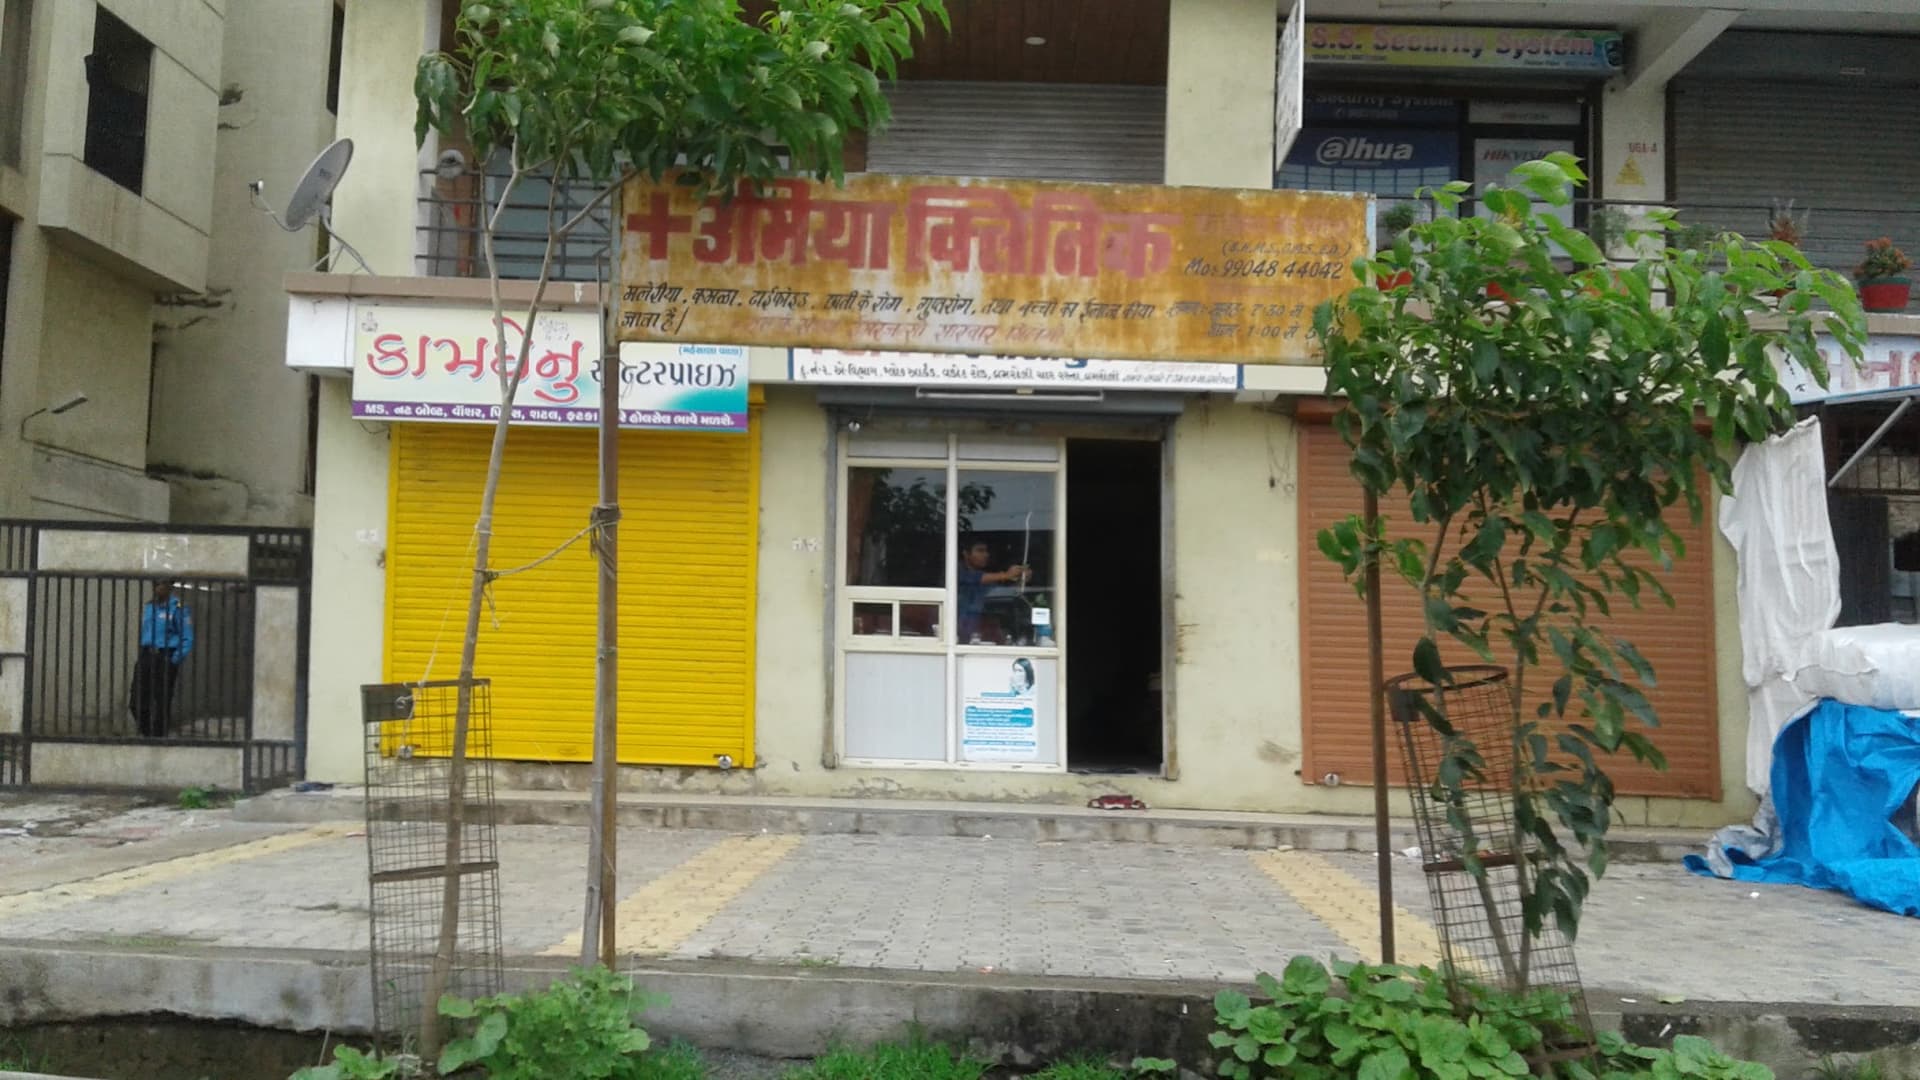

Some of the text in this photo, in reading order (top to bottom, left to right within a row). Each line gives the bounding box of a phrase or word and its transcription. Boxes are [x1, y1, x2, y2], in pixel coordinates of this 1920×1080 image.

[1373, 27, 1486, 58] Security
[1495, 31, 1594, 59] System
[1219, 259, 1280, 279] 99048
[1281, 260, 1344, 280] 44042
[367, 316, 585, 404] કામધેનુ
